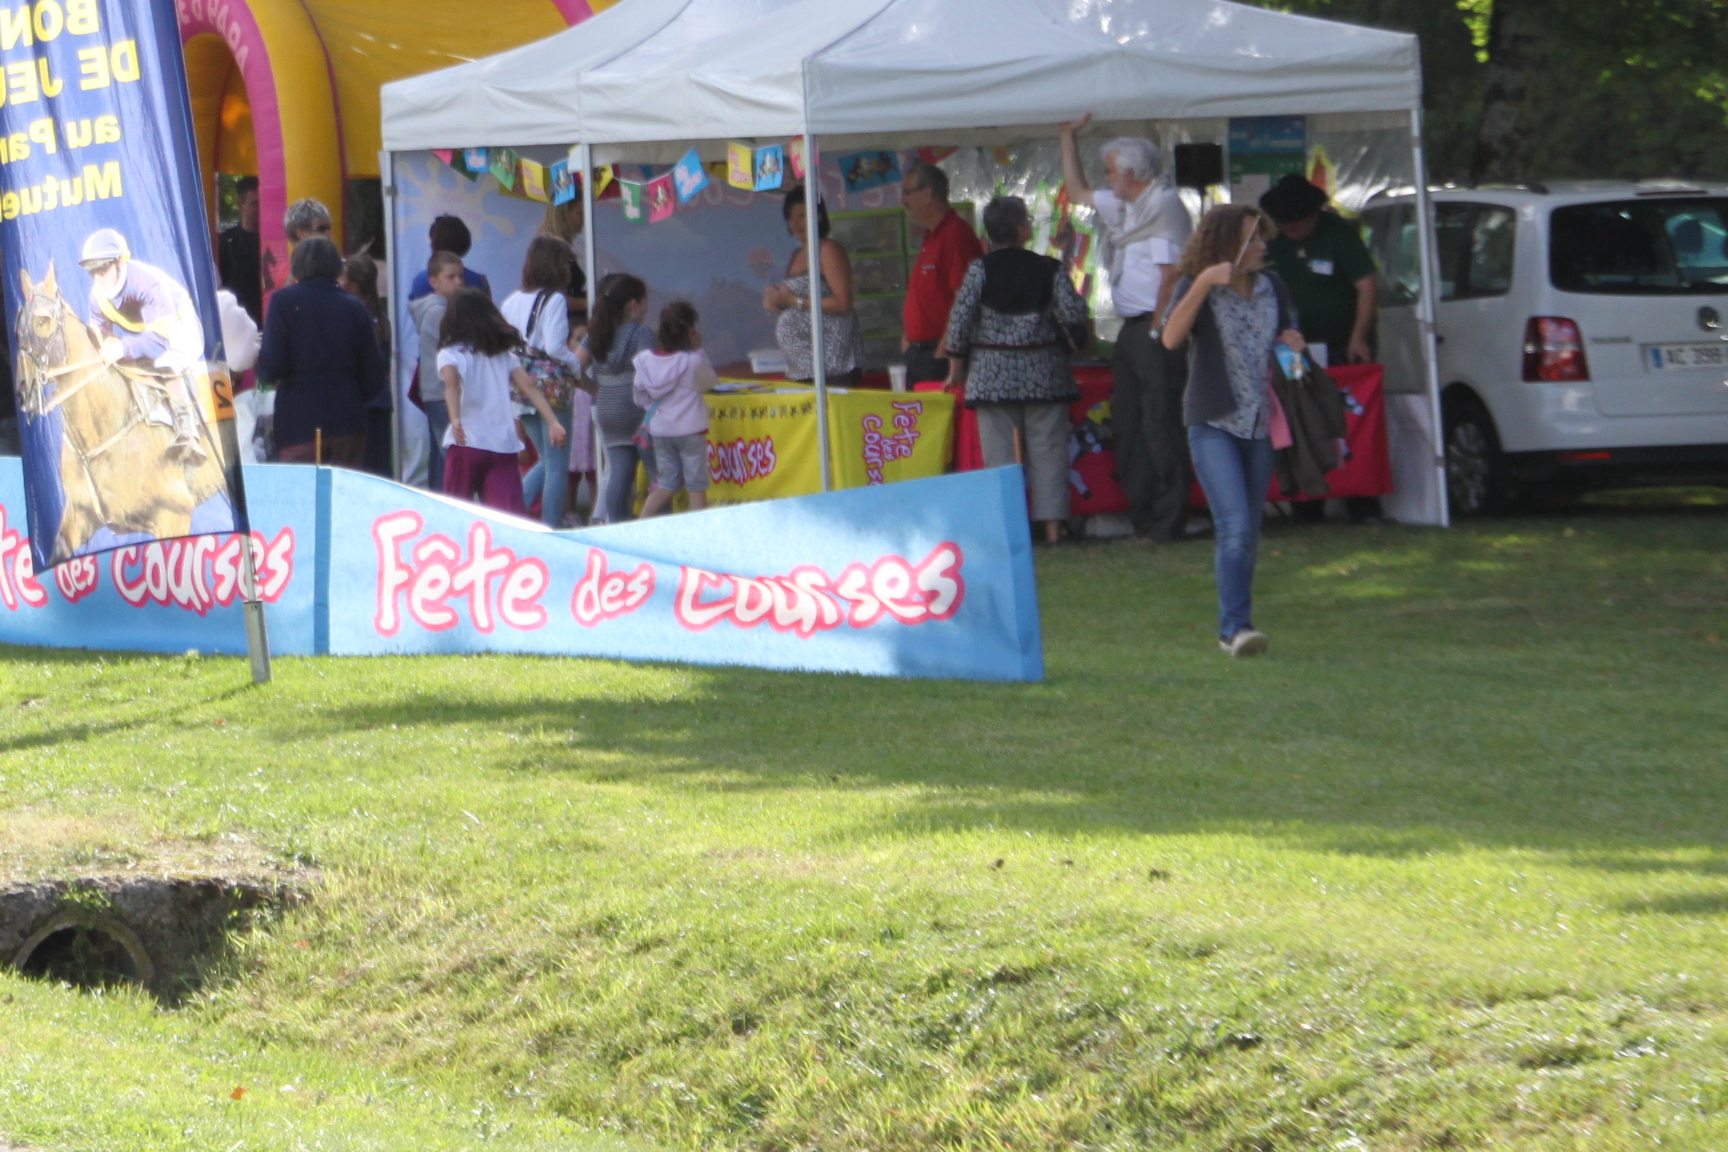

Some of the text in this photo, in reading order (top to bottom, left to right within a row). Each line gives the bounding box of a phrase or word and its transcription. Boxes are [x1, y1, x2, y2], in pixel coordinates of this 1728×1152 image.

[879, 437, 897, 462] des
[891, 399, 924, 459] Fête
[371, 509, 550, 638] Fête
[570, 547, 656, 630] des
